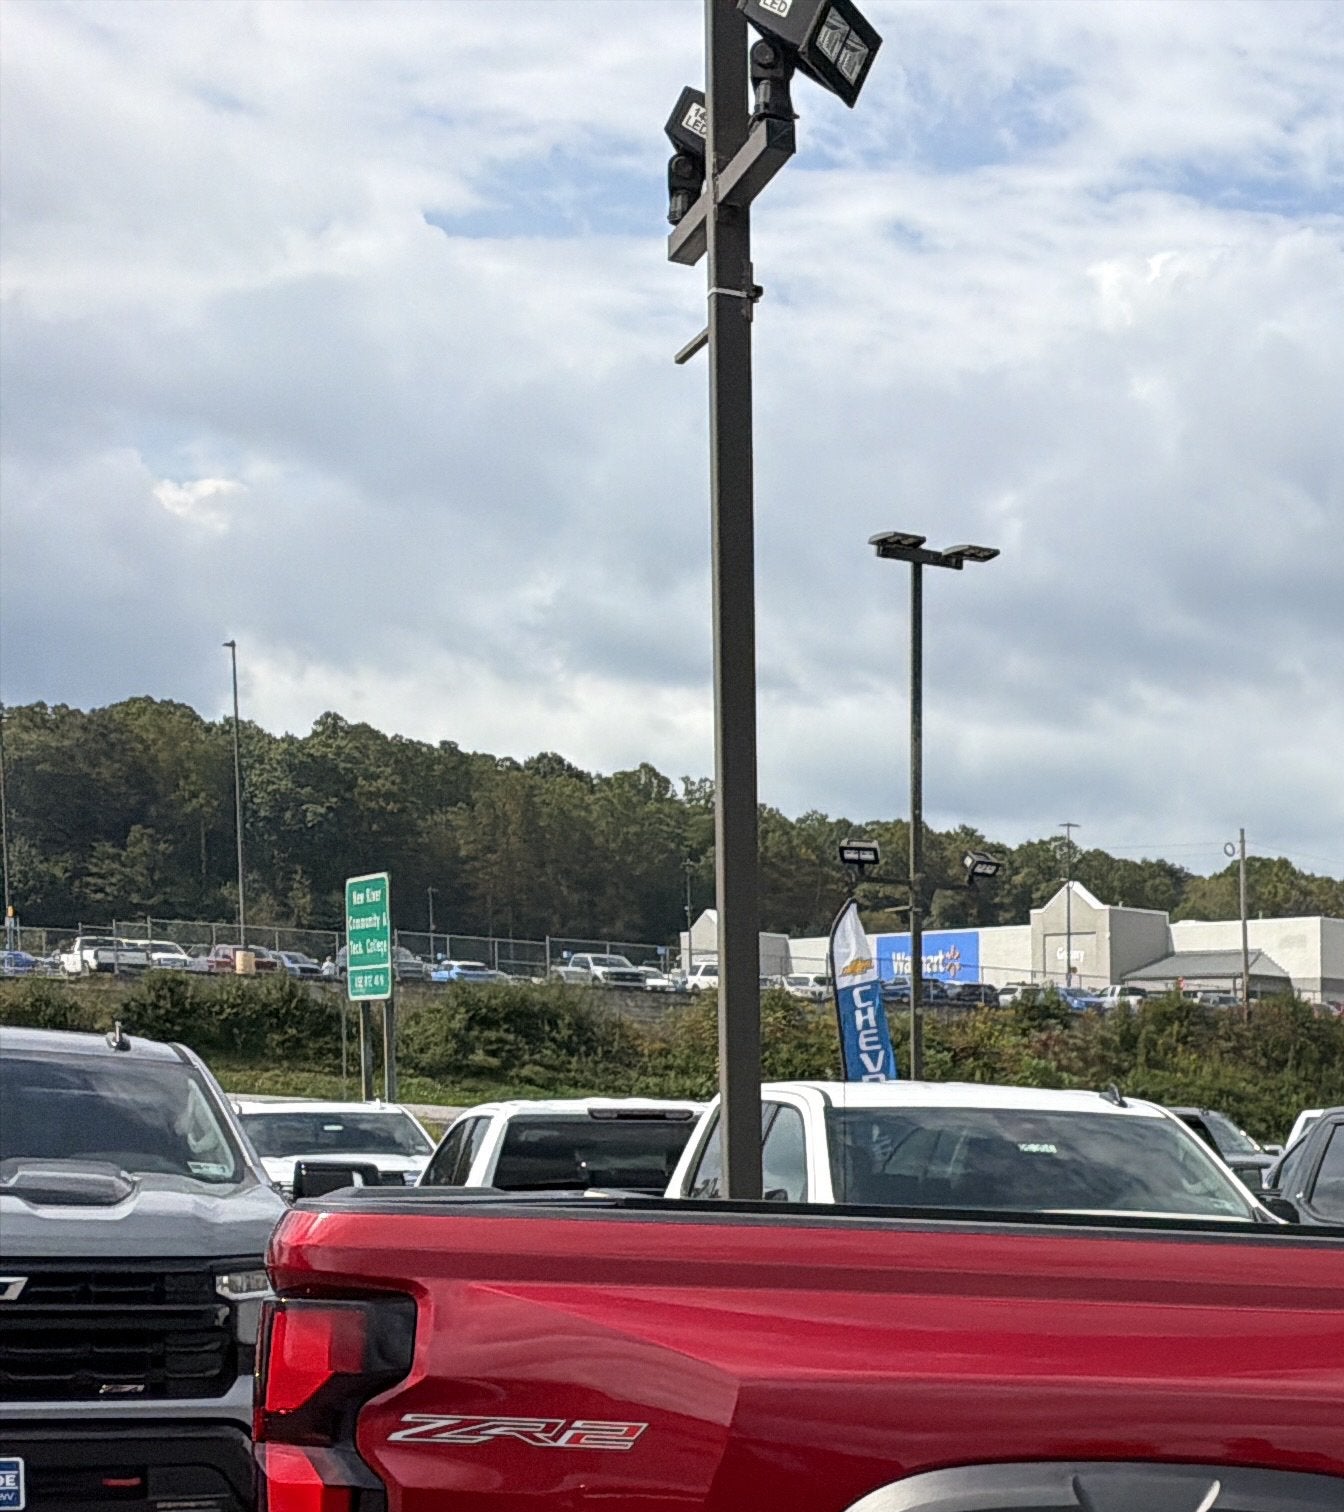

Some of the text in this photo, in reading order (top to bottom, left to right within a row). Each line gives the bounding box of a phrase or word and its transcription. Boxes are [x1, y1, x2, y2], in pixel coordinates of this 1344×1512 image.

[352, 888, 382, 905] New River
[366, 938, 387, 957] College
[386, 1413, 649, 1450] ZR2
